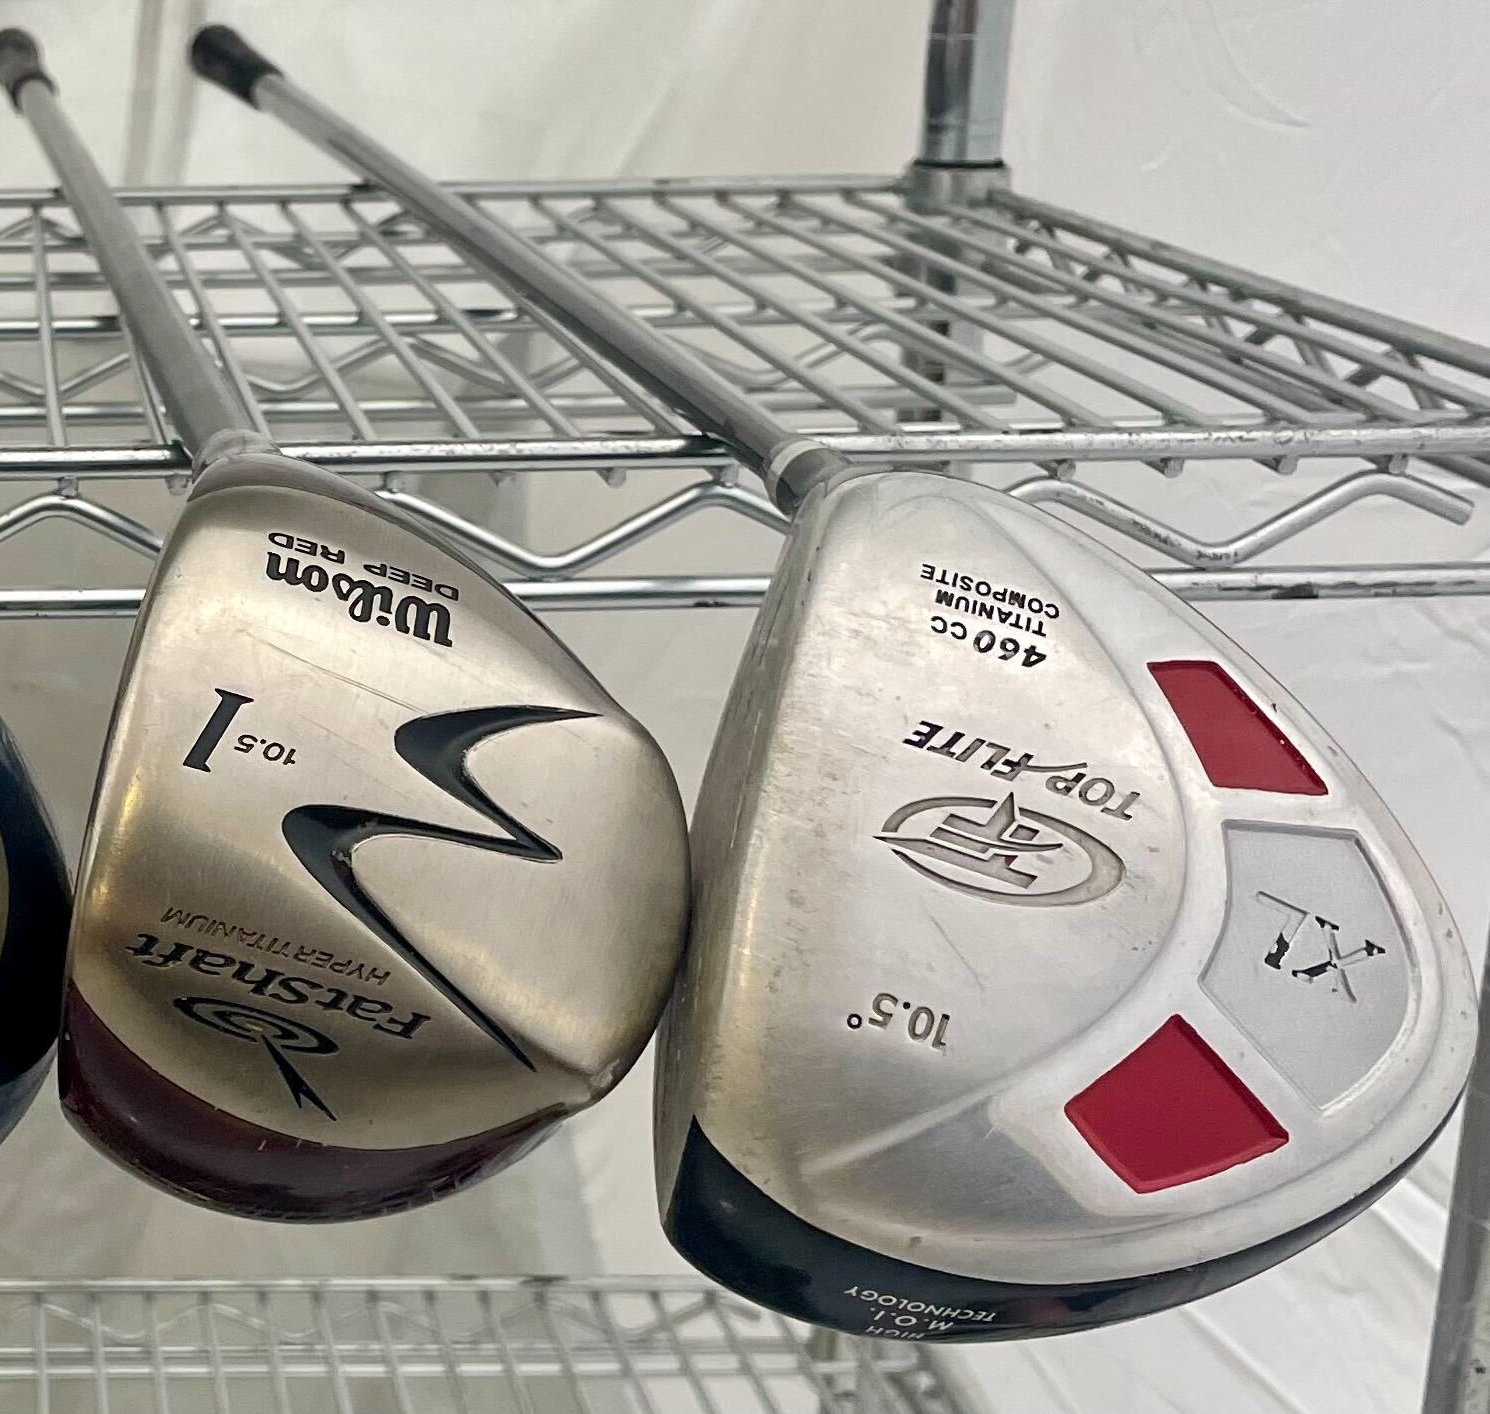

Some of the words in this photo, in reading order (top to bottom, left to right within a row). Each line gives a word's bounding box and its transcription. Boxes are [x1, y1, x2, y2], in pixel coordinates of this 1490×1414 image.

[268, 532, 346, 564] RED
[266, 551, 453, 647] Wilson
[363, 561, 459, 601] DEEP
[920, 563, 1060, 619] COMPOSITE
[930, 614, 967, 640] CC
[935, 589, 1047, 637] TITANIUM
[973, 630, 1047, 668] 460
[182, 688, 254, 772] 1
[234, 733, 297, 767] 10.5
[161, 908, 295, 958] TITANIUM
[1256, 890, 1386, 1003] XL
[126, 932, 432, 1039] FatShaft
[847, 992, 951, 1056] 10.5°
[845, 1285, 996, 1321] TECHNOLOGY
[865, 1325, 924, 1340] HIGH
